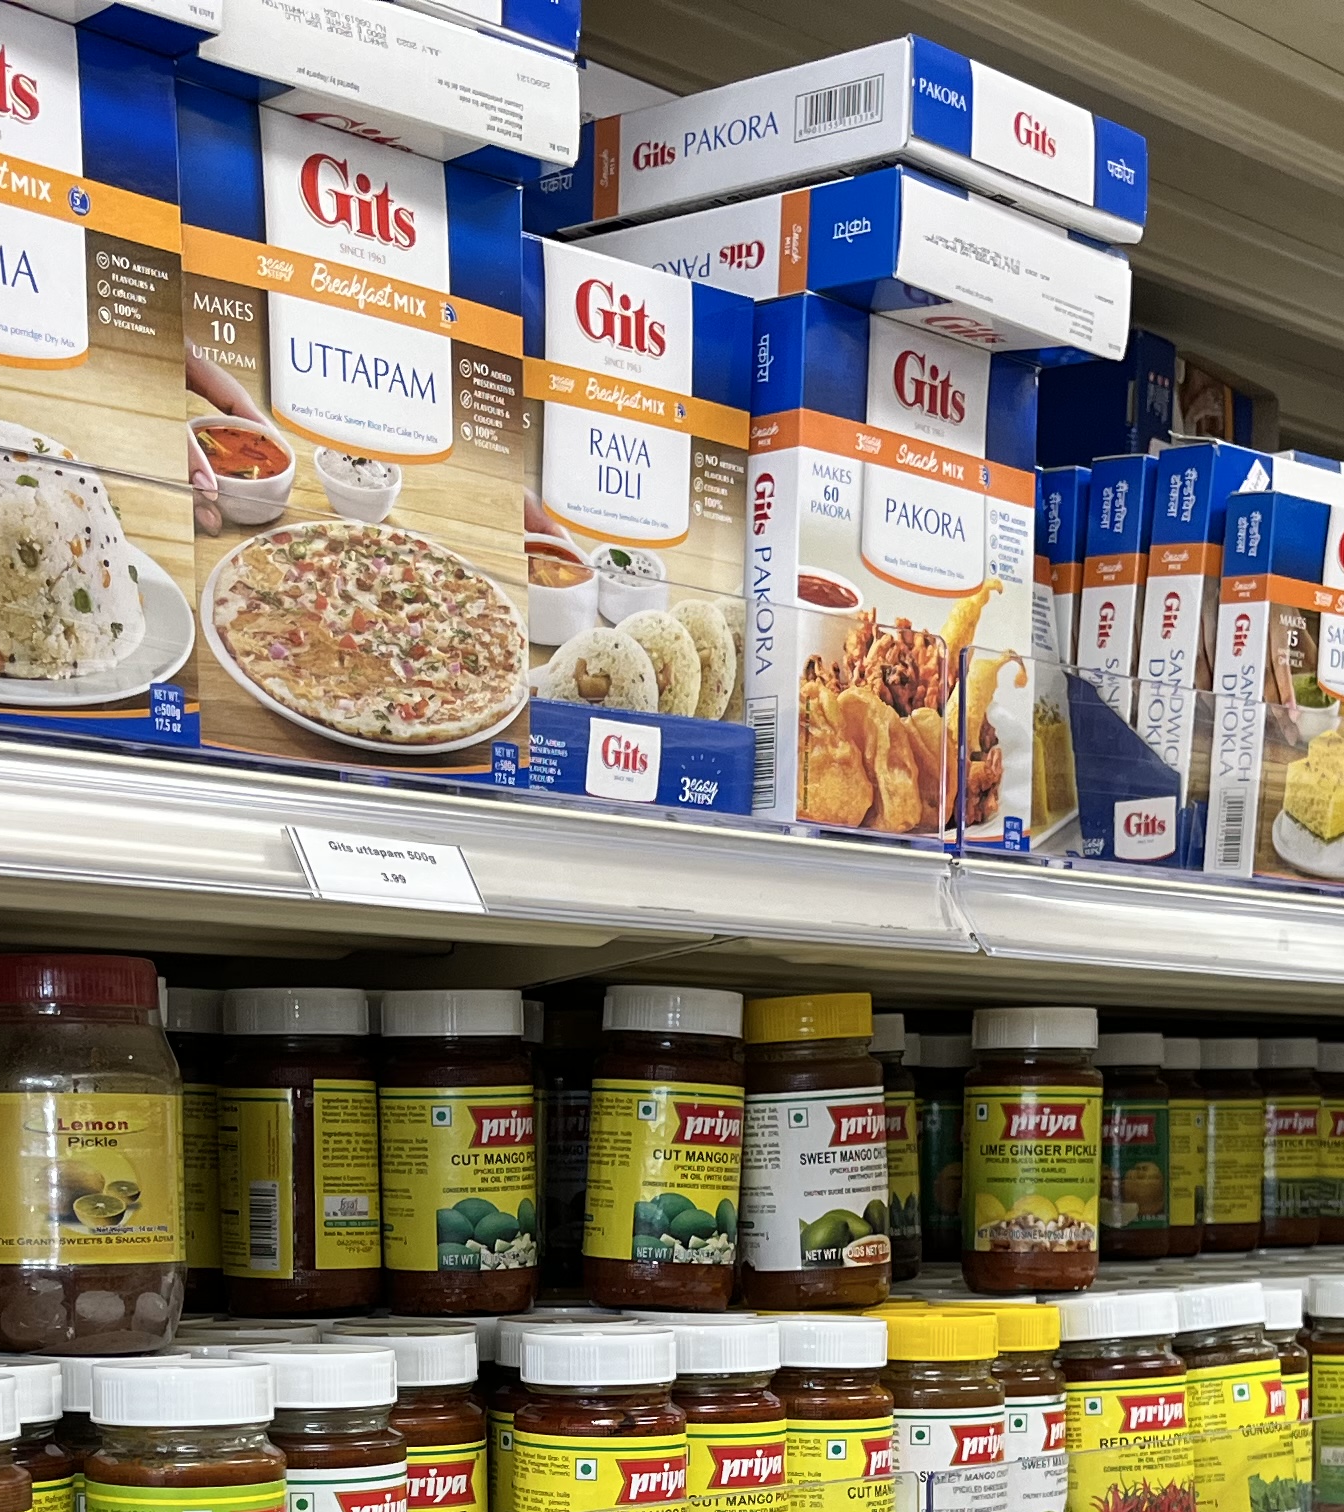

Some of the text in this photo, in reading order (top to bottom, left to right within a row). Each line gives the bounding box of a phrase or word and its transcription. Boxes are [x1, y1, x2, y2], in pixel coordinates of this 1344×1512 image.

[919, 77, 967, 112] PAKORA
[633, 111, 779, 171] Gits PAKORA
[1013, 111, 1056, 159] Gits
[10, 172, 52, 203] MIX
[300, 152, 417, 251] Gits
[193, 292, 254, 323] MAKES
[310, 262, 427, 320] Breakfast MIX
[575, 277, 667, 359] Gits
[192, 345, 257, 371] UTTAPAM
[290, 337, 437, 404] UTTAPAM
[892, 349, 966, 424] Gits
[589, 427, 651, 469] RAVA
[598, 466, 642, 500] IDLI
[884, 497, 966, 542] PAKORA
[601, 734, 649, 775] Gits
[328, 839, 437, 866] Gits uttapam 500g
[56, 1116, 130, 1133] Lemon
[1011, 1105, 1078, 1138] priya
[67, 1134, 119, 1149] Pickle
[799, 1149, 870, 1167] SWEET MANGO
[979, 1144, 1097, 1157] LIME GINGER PICKLE
[451, 1152, 519, 1167] CUT MANGO
[1129, 1401, 1182, 1429] priya
[629, 1463, 685, 1500] priya
[847, 1484, 872, 1500] CUT
